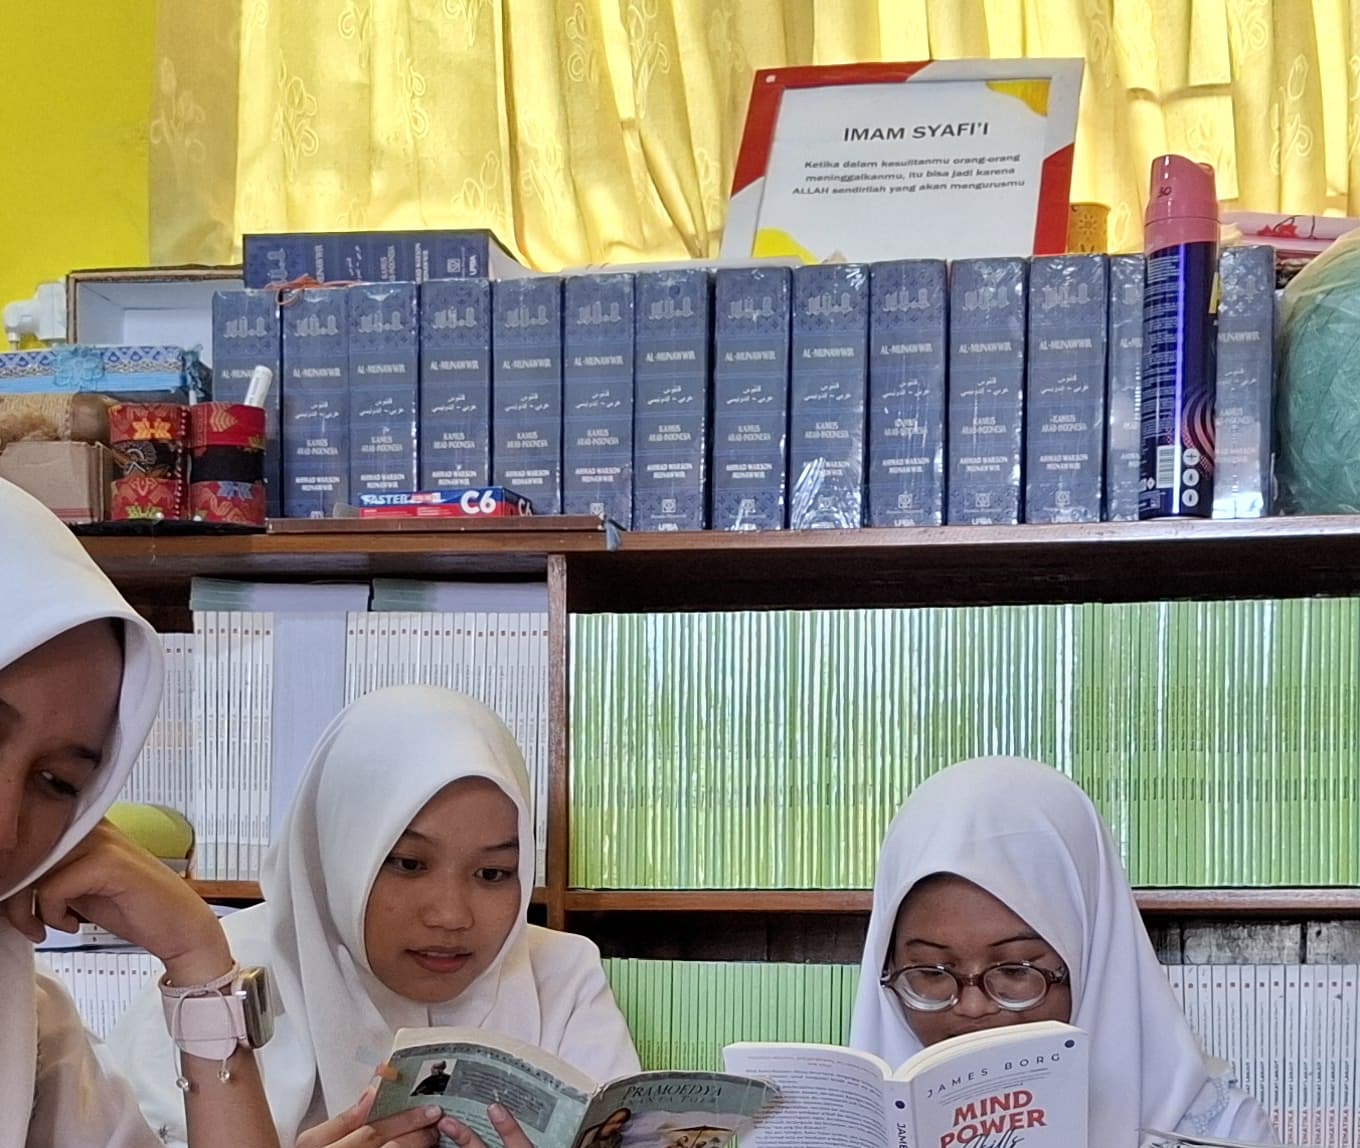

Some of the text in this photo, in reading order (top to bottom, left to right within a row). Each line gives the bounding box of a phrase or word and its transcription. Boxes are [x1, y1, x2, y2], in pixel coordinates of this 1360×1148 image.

[843, 122, 990, 142] IMAM SYAFI'I
[804, 154, 1021, 169] Ketika dalam kesulitanmu orang-orang
[926, 169, 950, 178] bisa
[951, 169, 973, 178] jadi
[976, 167, 1015, 176] karena
[792, 186, 830, 195] ALLAH
[889, 184, 916, 194] yang
[918, 181, 947, 190] akan
[950, 179, 1025, 191] mengurusmu
[460, 490, 496, 514] C6
[927, 1068, 988, 1098] JAMES
[1004, 1053, 1060, 1070] BORG
[952, 1090, 1033, 1128] MIND
[1328, 1109, 1337, 1148] TEMATIKA
[1342, 1109, 1350, 1148] TEMATIKA
